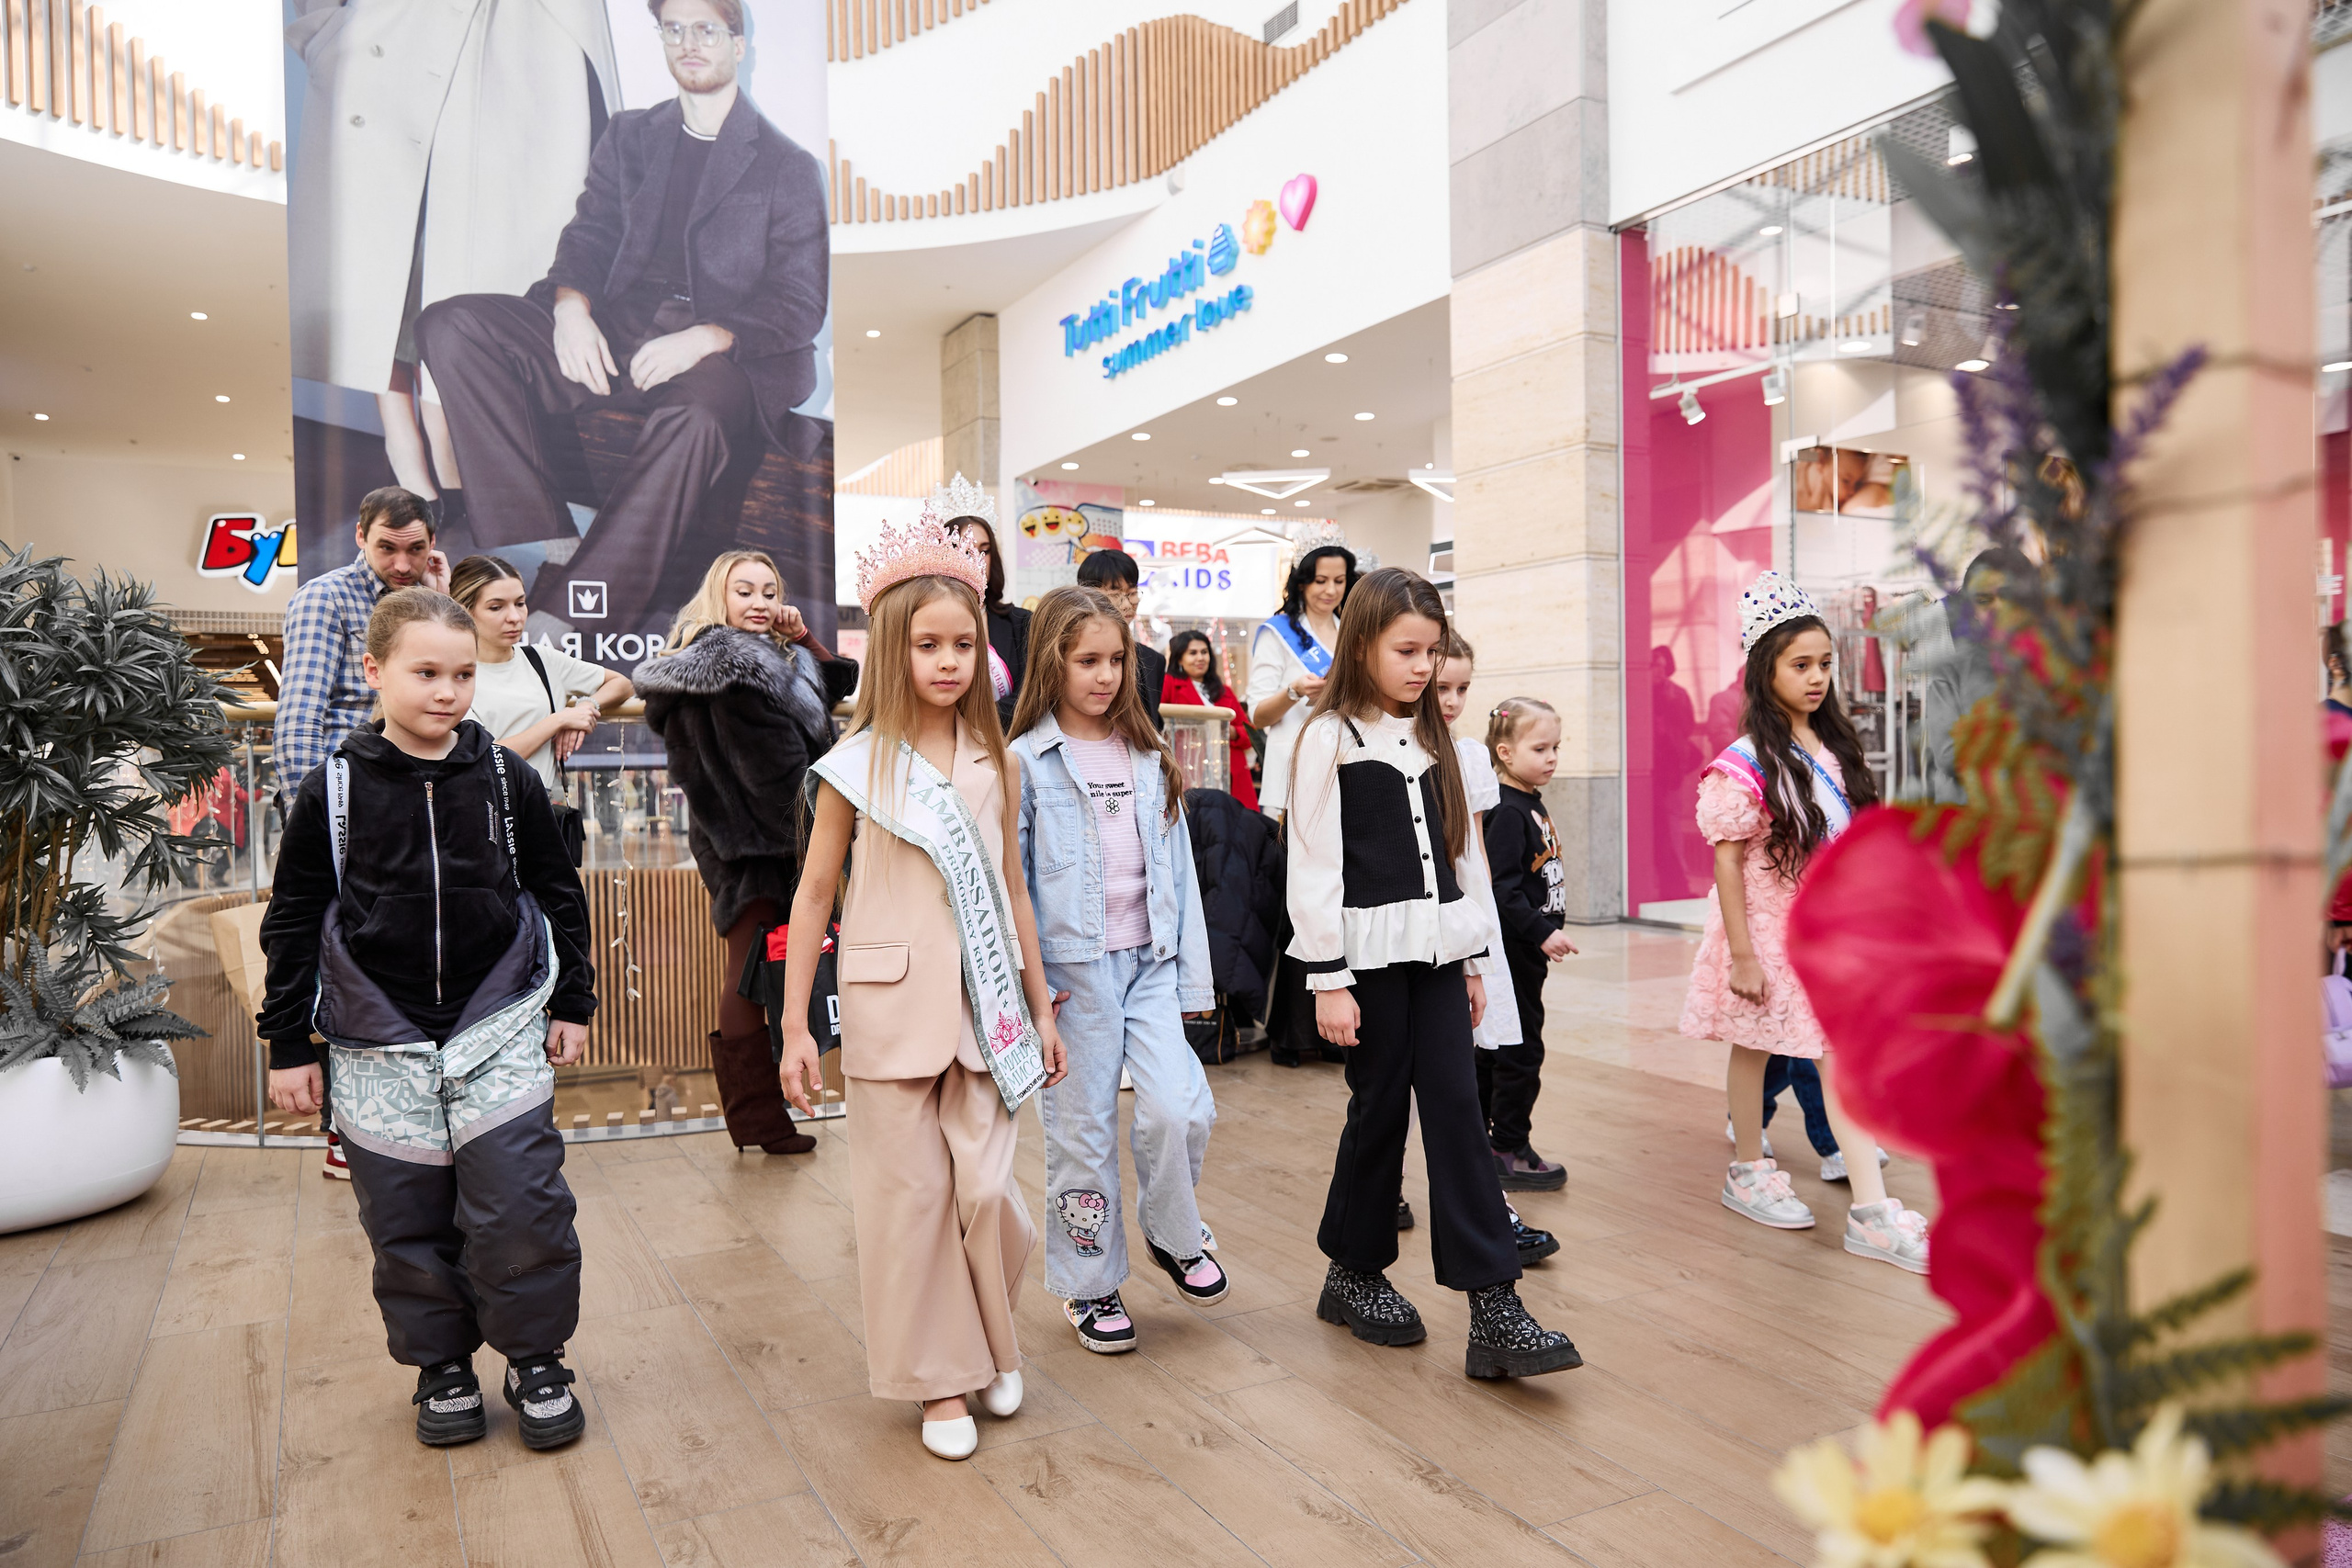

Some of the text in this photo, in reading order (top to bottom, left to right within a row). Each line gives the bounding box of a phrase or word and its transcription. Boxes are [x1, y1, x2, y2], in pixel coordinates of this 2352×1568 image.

[1059, 239, 1205, 357] Tutti Frutti
[1102, 284, 1253, 379] summer love
[1173, 567, 1232, 591] IDS
[908, 786, 1009, 998] AMBASSADOR
[941, 843, 988, 985] PRIMORSKY KRAI
[999, 1042, 1035, 1076] МИНИ
[1007, 1055, 1042, 1091] МИСС
[1071, 1308, 1088, 1316] cool
